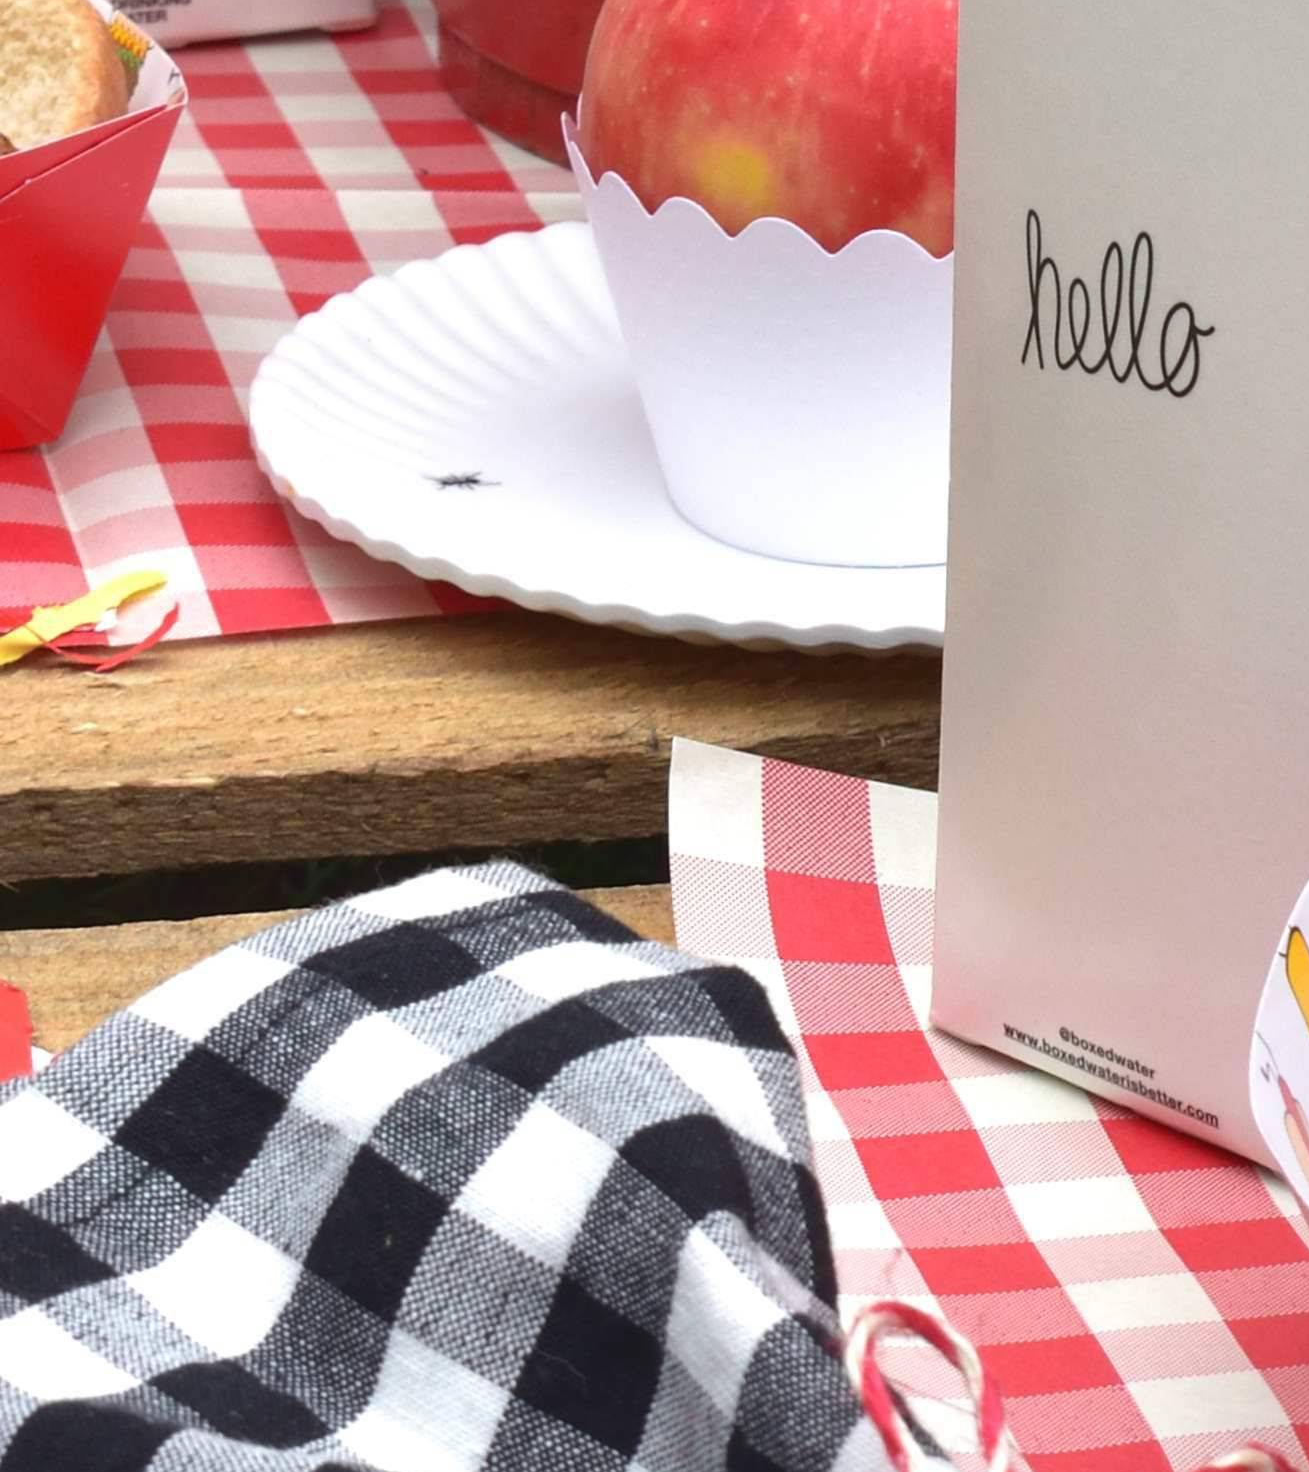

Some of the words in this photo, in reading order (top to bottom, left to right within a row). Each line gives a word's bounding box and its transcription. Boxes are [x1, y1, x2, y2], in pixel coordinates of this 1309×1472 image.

[1020, 208, 1216, 398] hello
[1003, 1021, 1220, 1129] www.boxedwaterisbetter.com
[1058, 1026, 1156, 1079] @boxedwater
